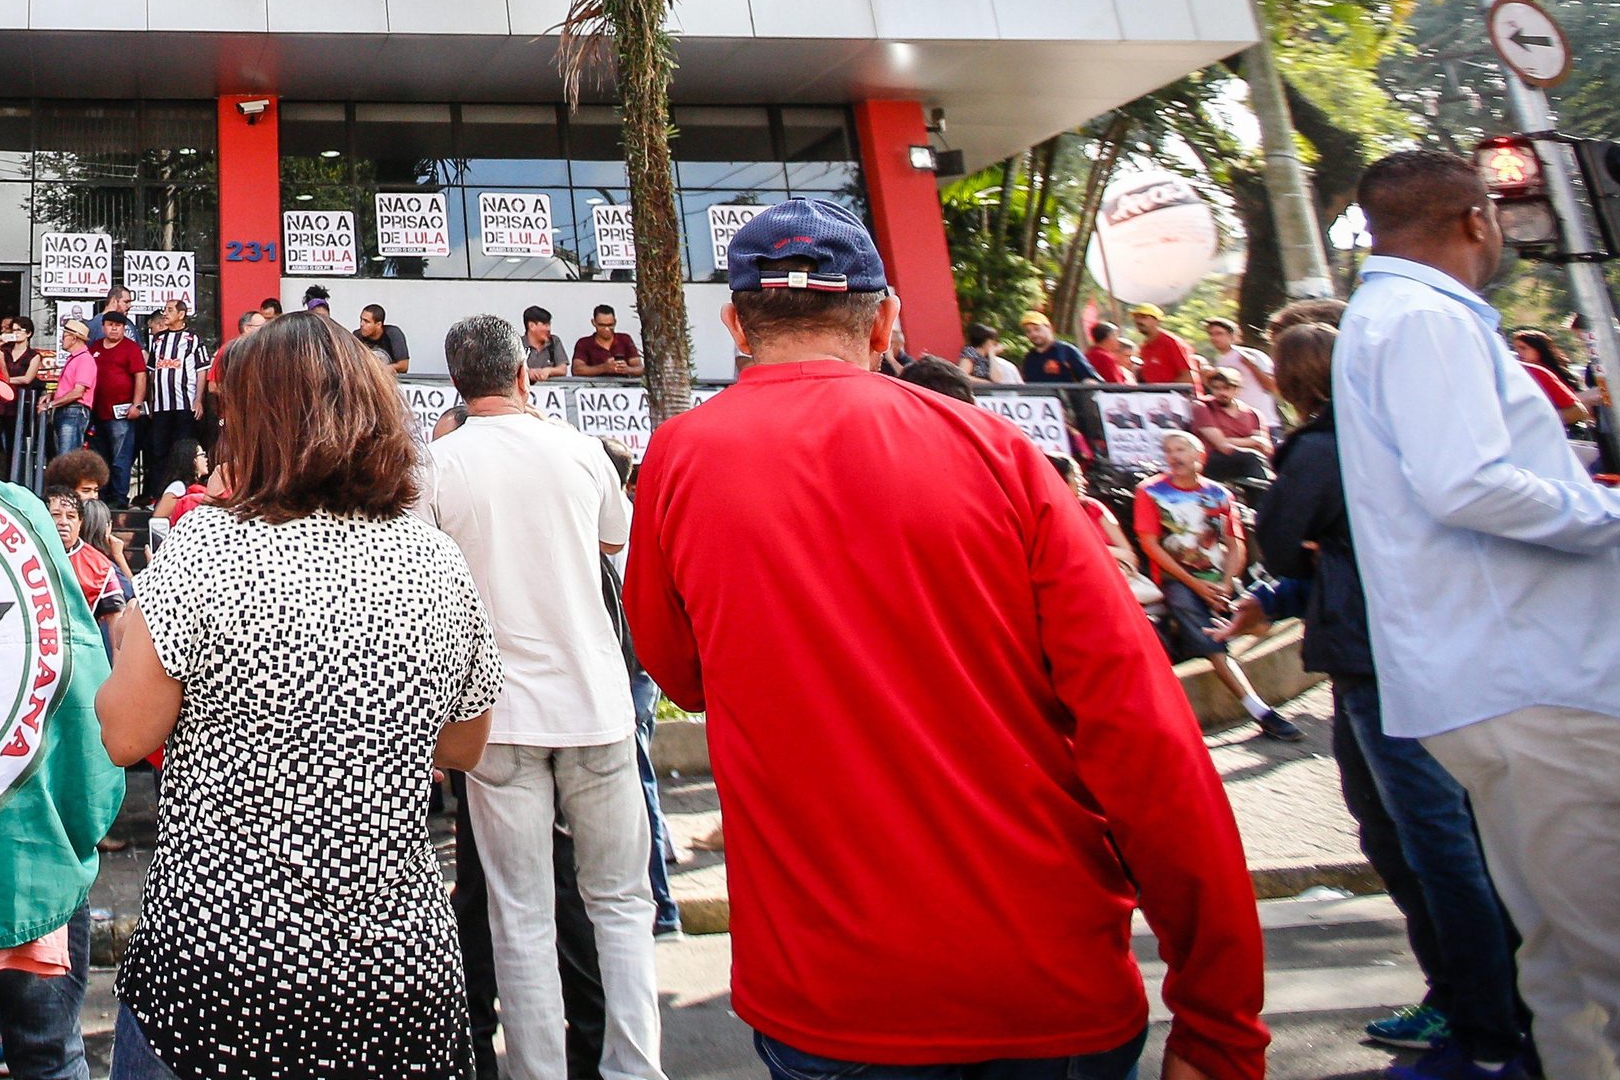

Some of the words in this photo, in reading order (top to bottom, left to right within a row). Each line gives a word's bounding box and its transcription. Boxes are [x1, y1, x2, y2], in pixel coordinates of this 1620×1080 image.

[381, 231, 401, 244] DE
[405, 232, 445, 244] LULA
[485, 231, 505, 244] DE
[509, 232, 549, 245] LULA
[598, 228, 634, 241] PRIS
[226, 240, 276, 262] 231
[288, 249, 308, 262] DE
[312, 249, 353, 262] LULA
[600, 245, 621, 257] DE
[44, 271, 64, 284] DE
[68, 272, 108, 285] LULA
[130, 290, 146, 302] DE
[151, 290, 191, 304] LULA
[0, 554, 59, 757] URBANA
